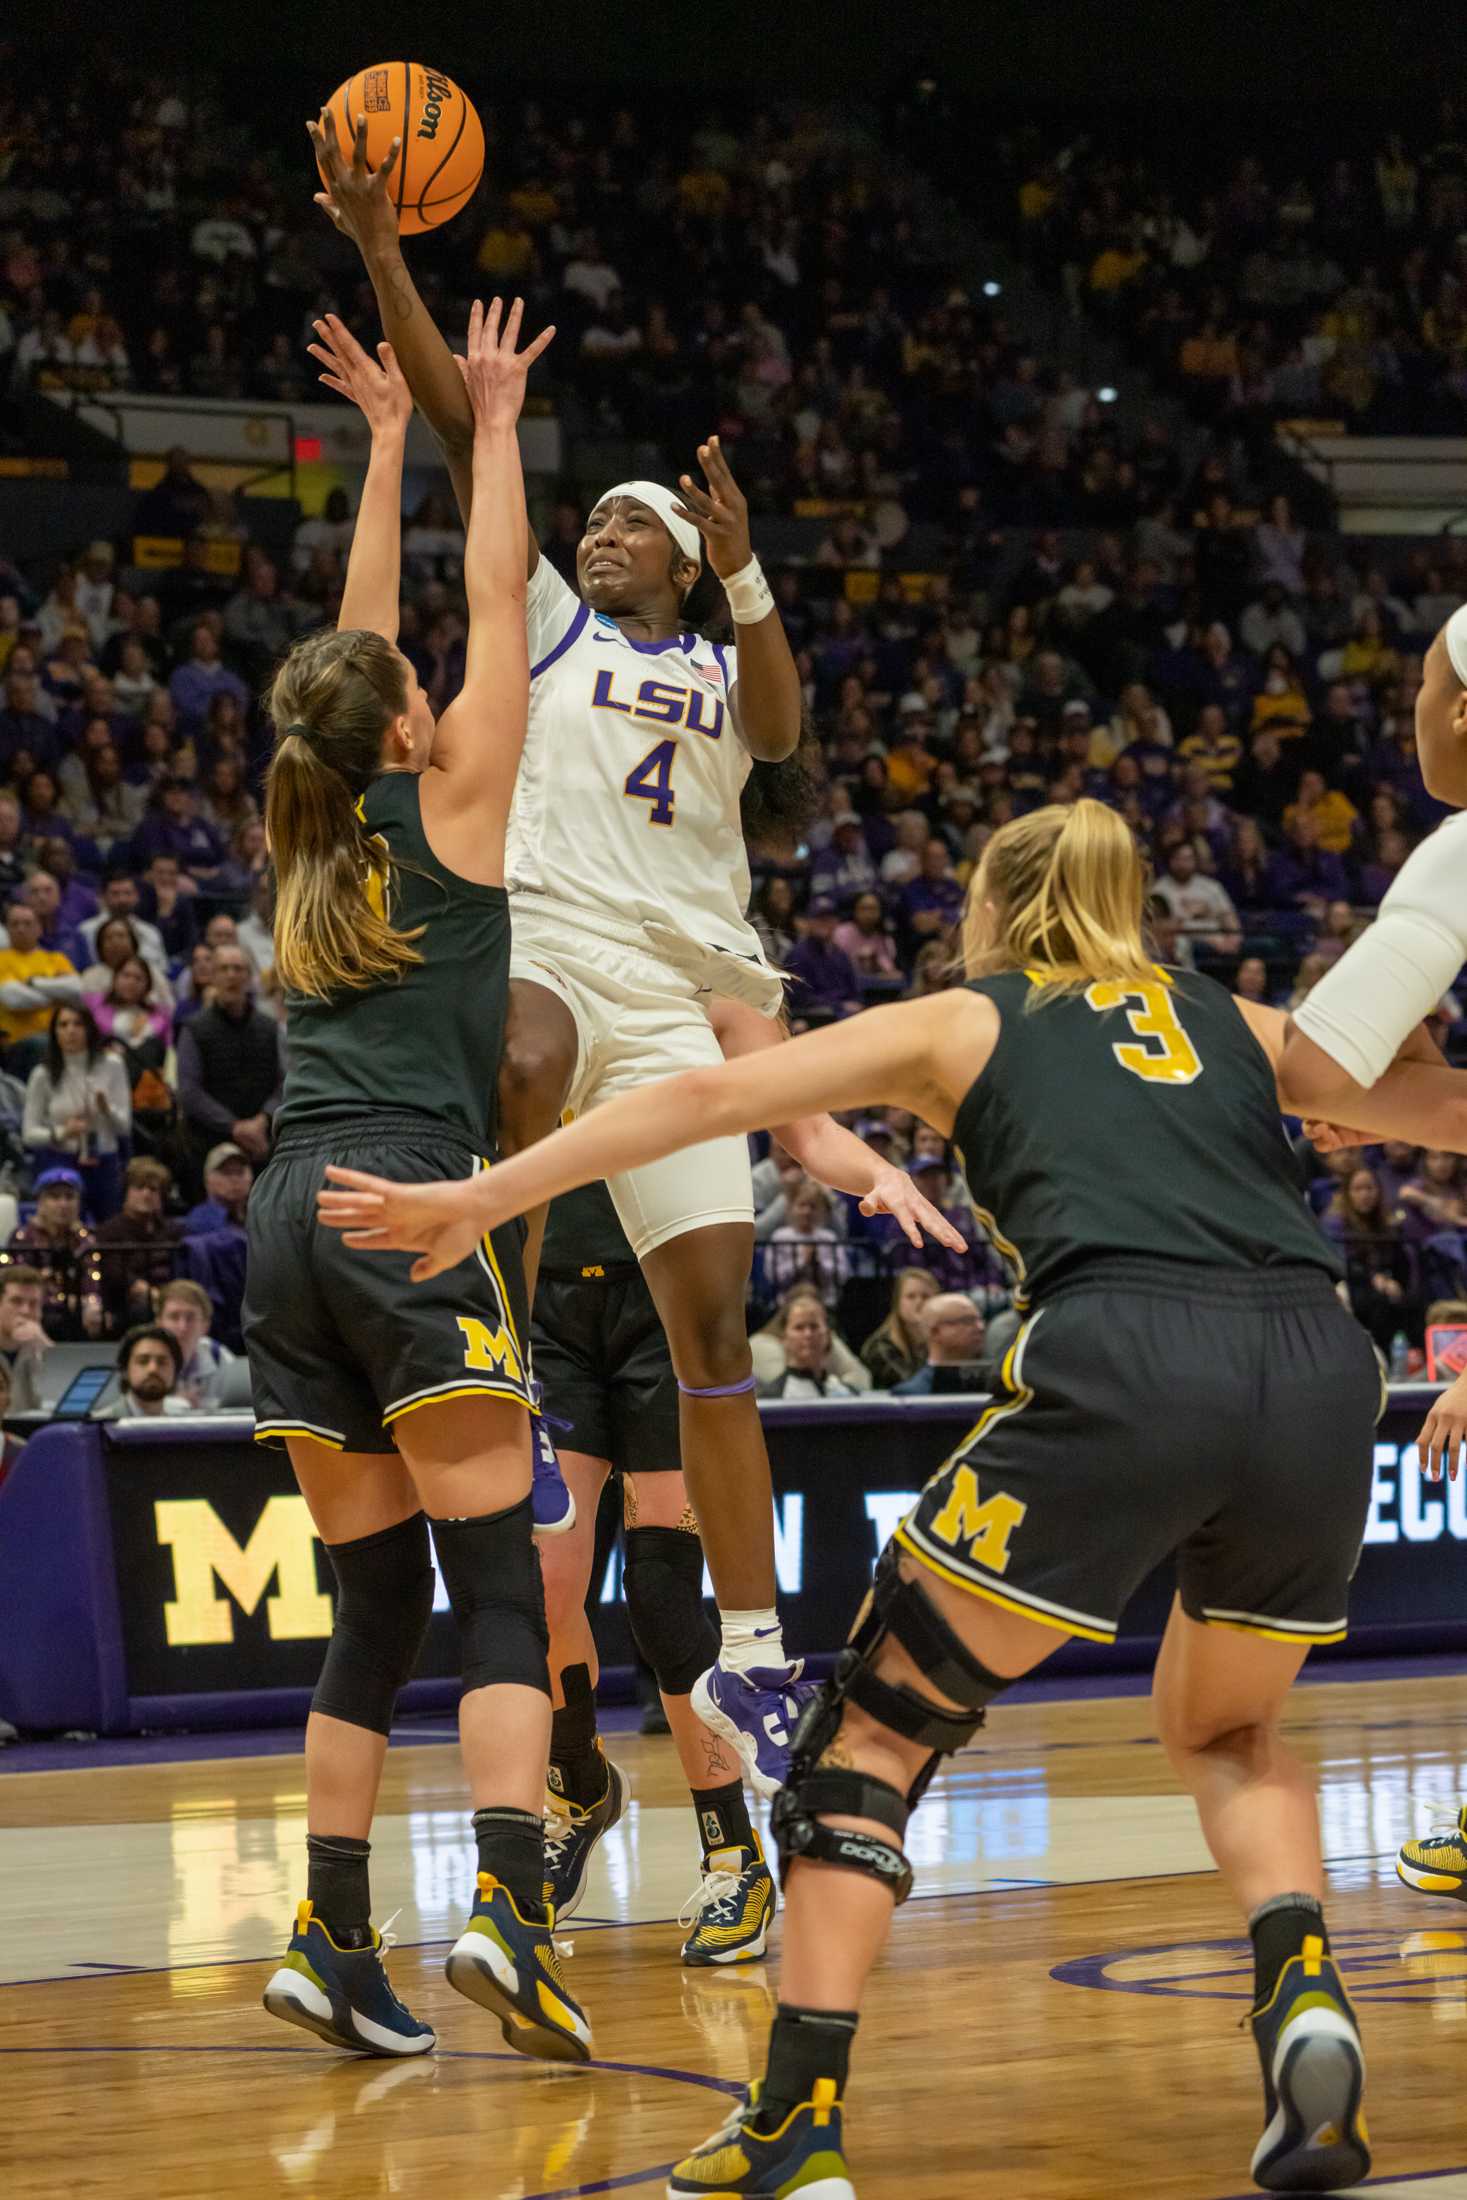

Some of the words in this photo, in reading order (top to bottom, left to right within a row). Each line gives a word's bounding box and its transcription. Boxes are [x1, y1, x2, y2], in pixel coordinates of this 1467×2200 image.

[592, 669, 725, 740] LSU
[623, 738, 678, 828] 4
[1084, 980, 1204, 1085] 3
[456, 1316, 523, 1383] M
[930, 1463, 1027, 1575] M
[154, 1494, 335, 1647] M
